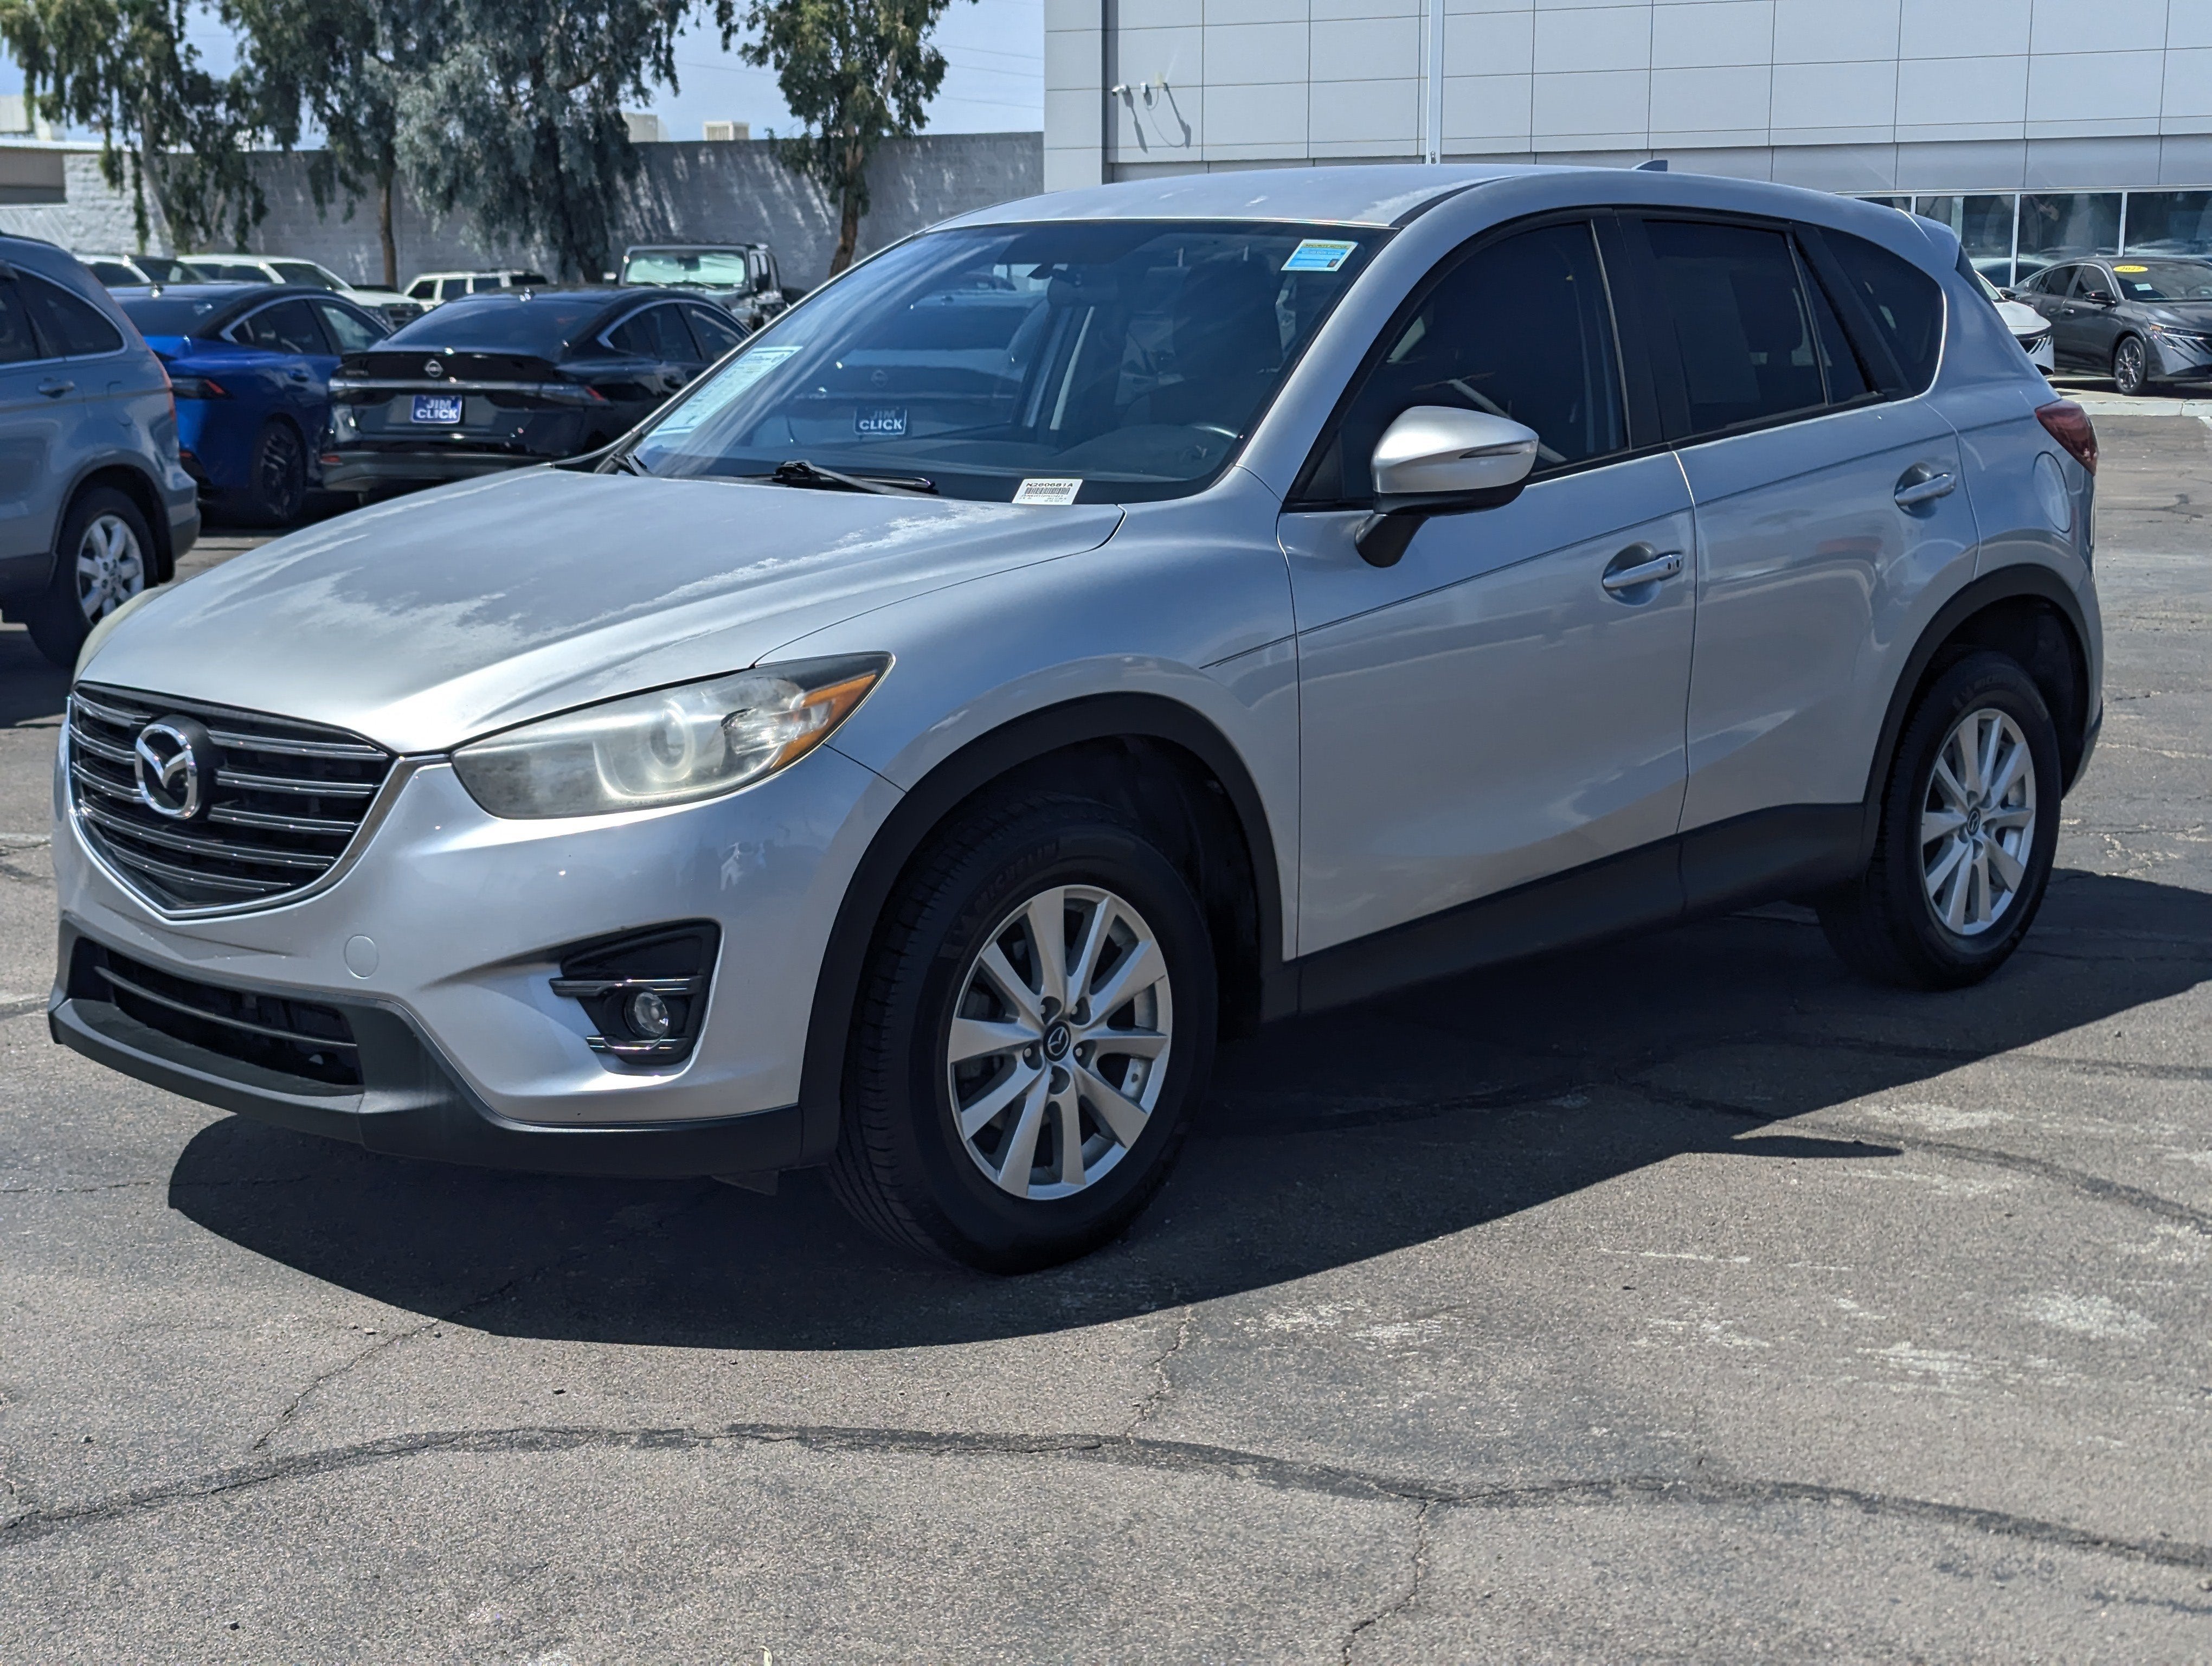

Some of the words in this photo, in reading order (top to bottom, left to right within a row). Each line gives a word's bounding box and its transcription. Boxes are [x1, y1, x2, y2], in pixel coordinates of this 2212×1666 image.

[426, 400, 451, 409] JIM
[416, 409, 457, 419] CLICK
[870, 410, 896, 419] JIM
[859, 419, 902, 430] CLICK
